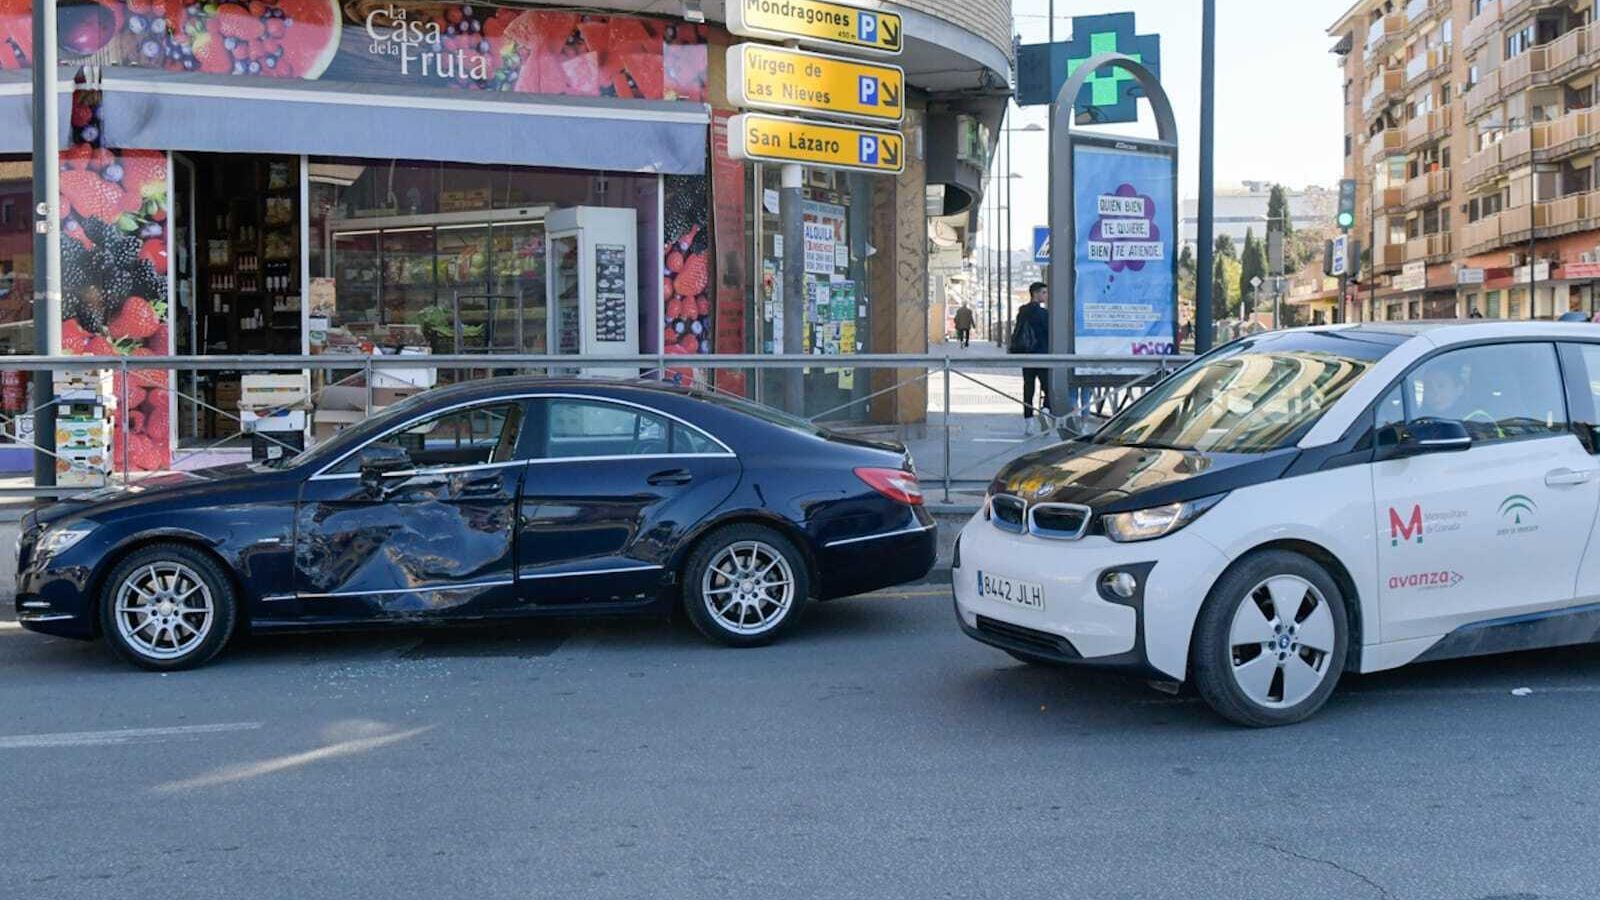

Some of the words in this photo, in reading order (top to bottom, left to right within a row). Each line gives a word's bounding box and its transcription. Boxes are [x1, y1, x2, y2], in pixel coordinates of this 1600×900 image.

[389, 4, 407, 20] La
[747, 0, 850, 26] Mondragones
[861, 14, 875, 39] P
[366, 9, 441, 44] Casa
[401, 42, 488, 79] Fruta
[747, 79, 773, 97] Las
[783, 83, 831, 104] Nieves
[748, 53, 795, 75] Virgen
[804, 62, 822, 78] de
[861, 77, 876, 102] P
[750, 128, 781, 147] San
[789, 132, 840, 153] Lázaro
[861, 136, 876, 162] P
[1100, 198, 1121, 212] QUIEN
[1125, 200, 1142, 213] BIEN
[1104, 222, 1114, 235] TE
[1090, 244, 1109, 258] BIEN
[1115, 245, 1125, 257] TE
[984, 576, 1012, 601] 8442
[1016, 583, 1041, 607] JLH
[1389, 570, 1449, 589] avanza
